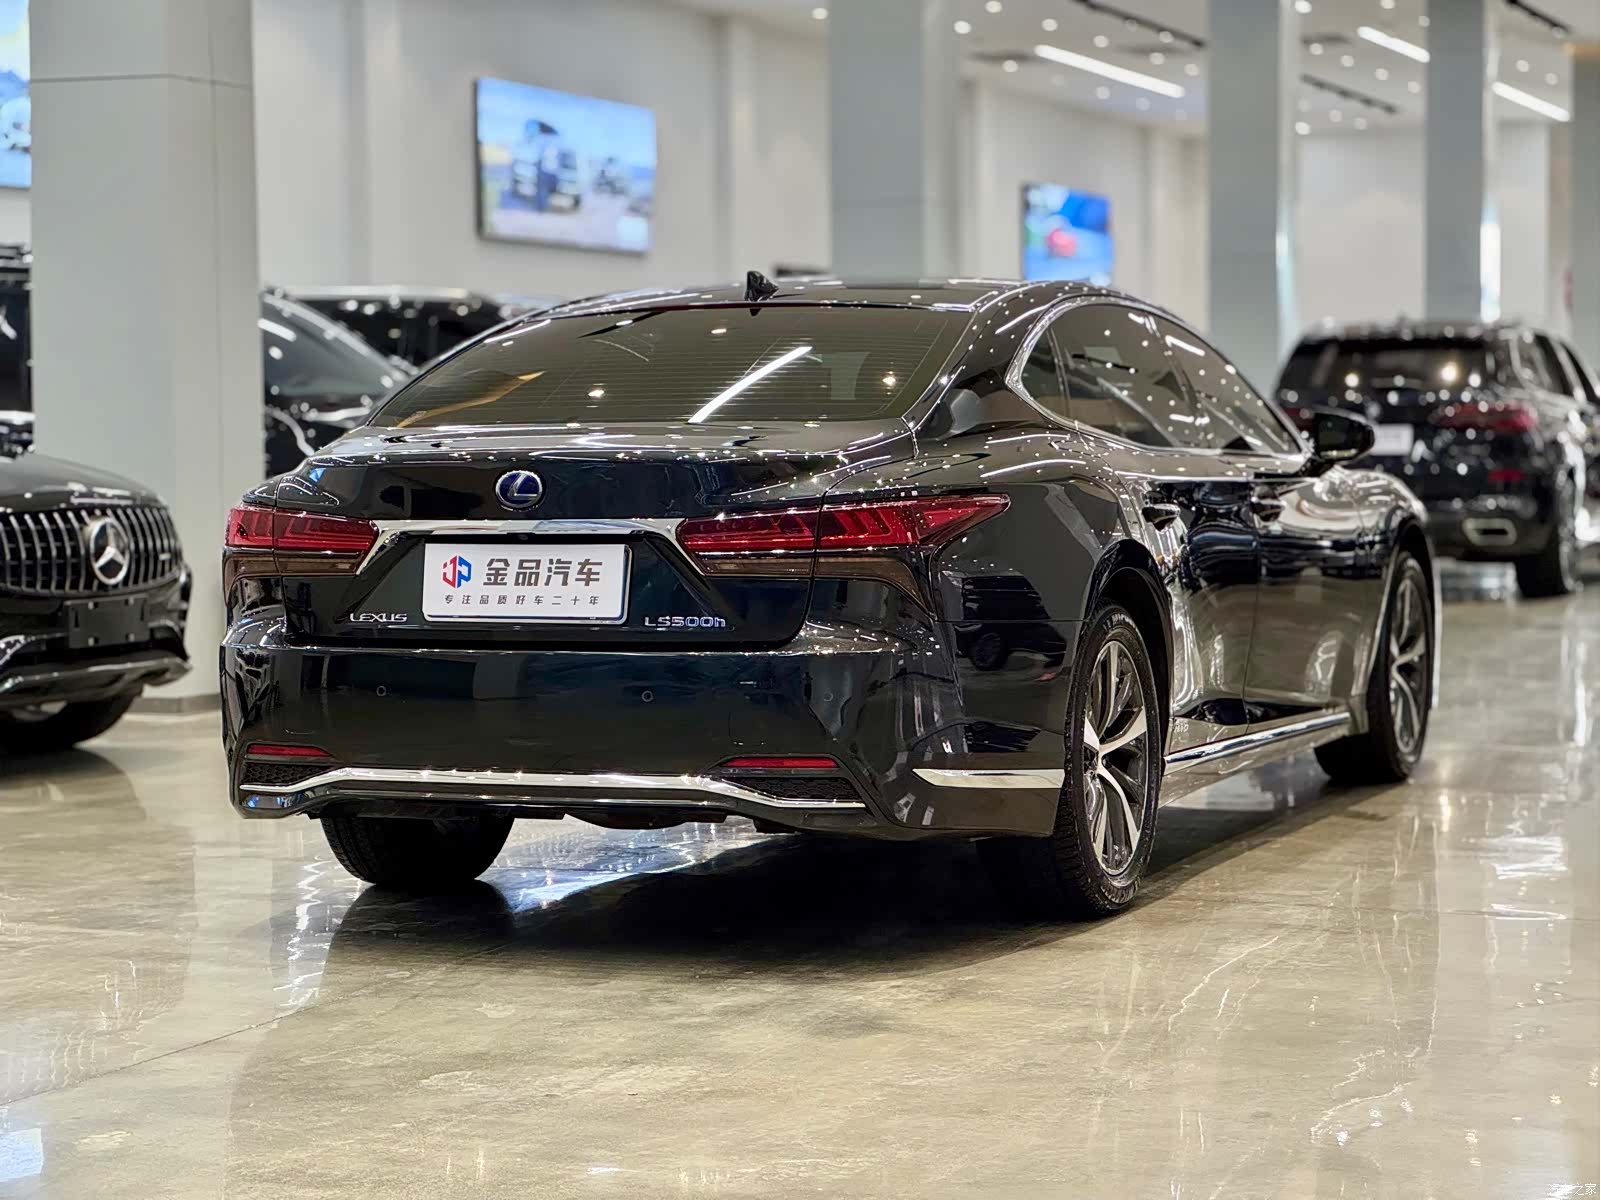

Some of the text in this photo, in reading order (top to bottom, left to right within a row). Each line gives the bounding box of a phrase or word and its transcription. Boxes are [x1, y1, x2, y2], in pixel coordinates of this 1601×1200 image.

[482, 558, 603, 587] 金品汽车
[444, 594, 600, 606] 专注品质好车二十年
[349, 613, 408, 623] LEXUS
[644, 616, 727, 628] LS500h
